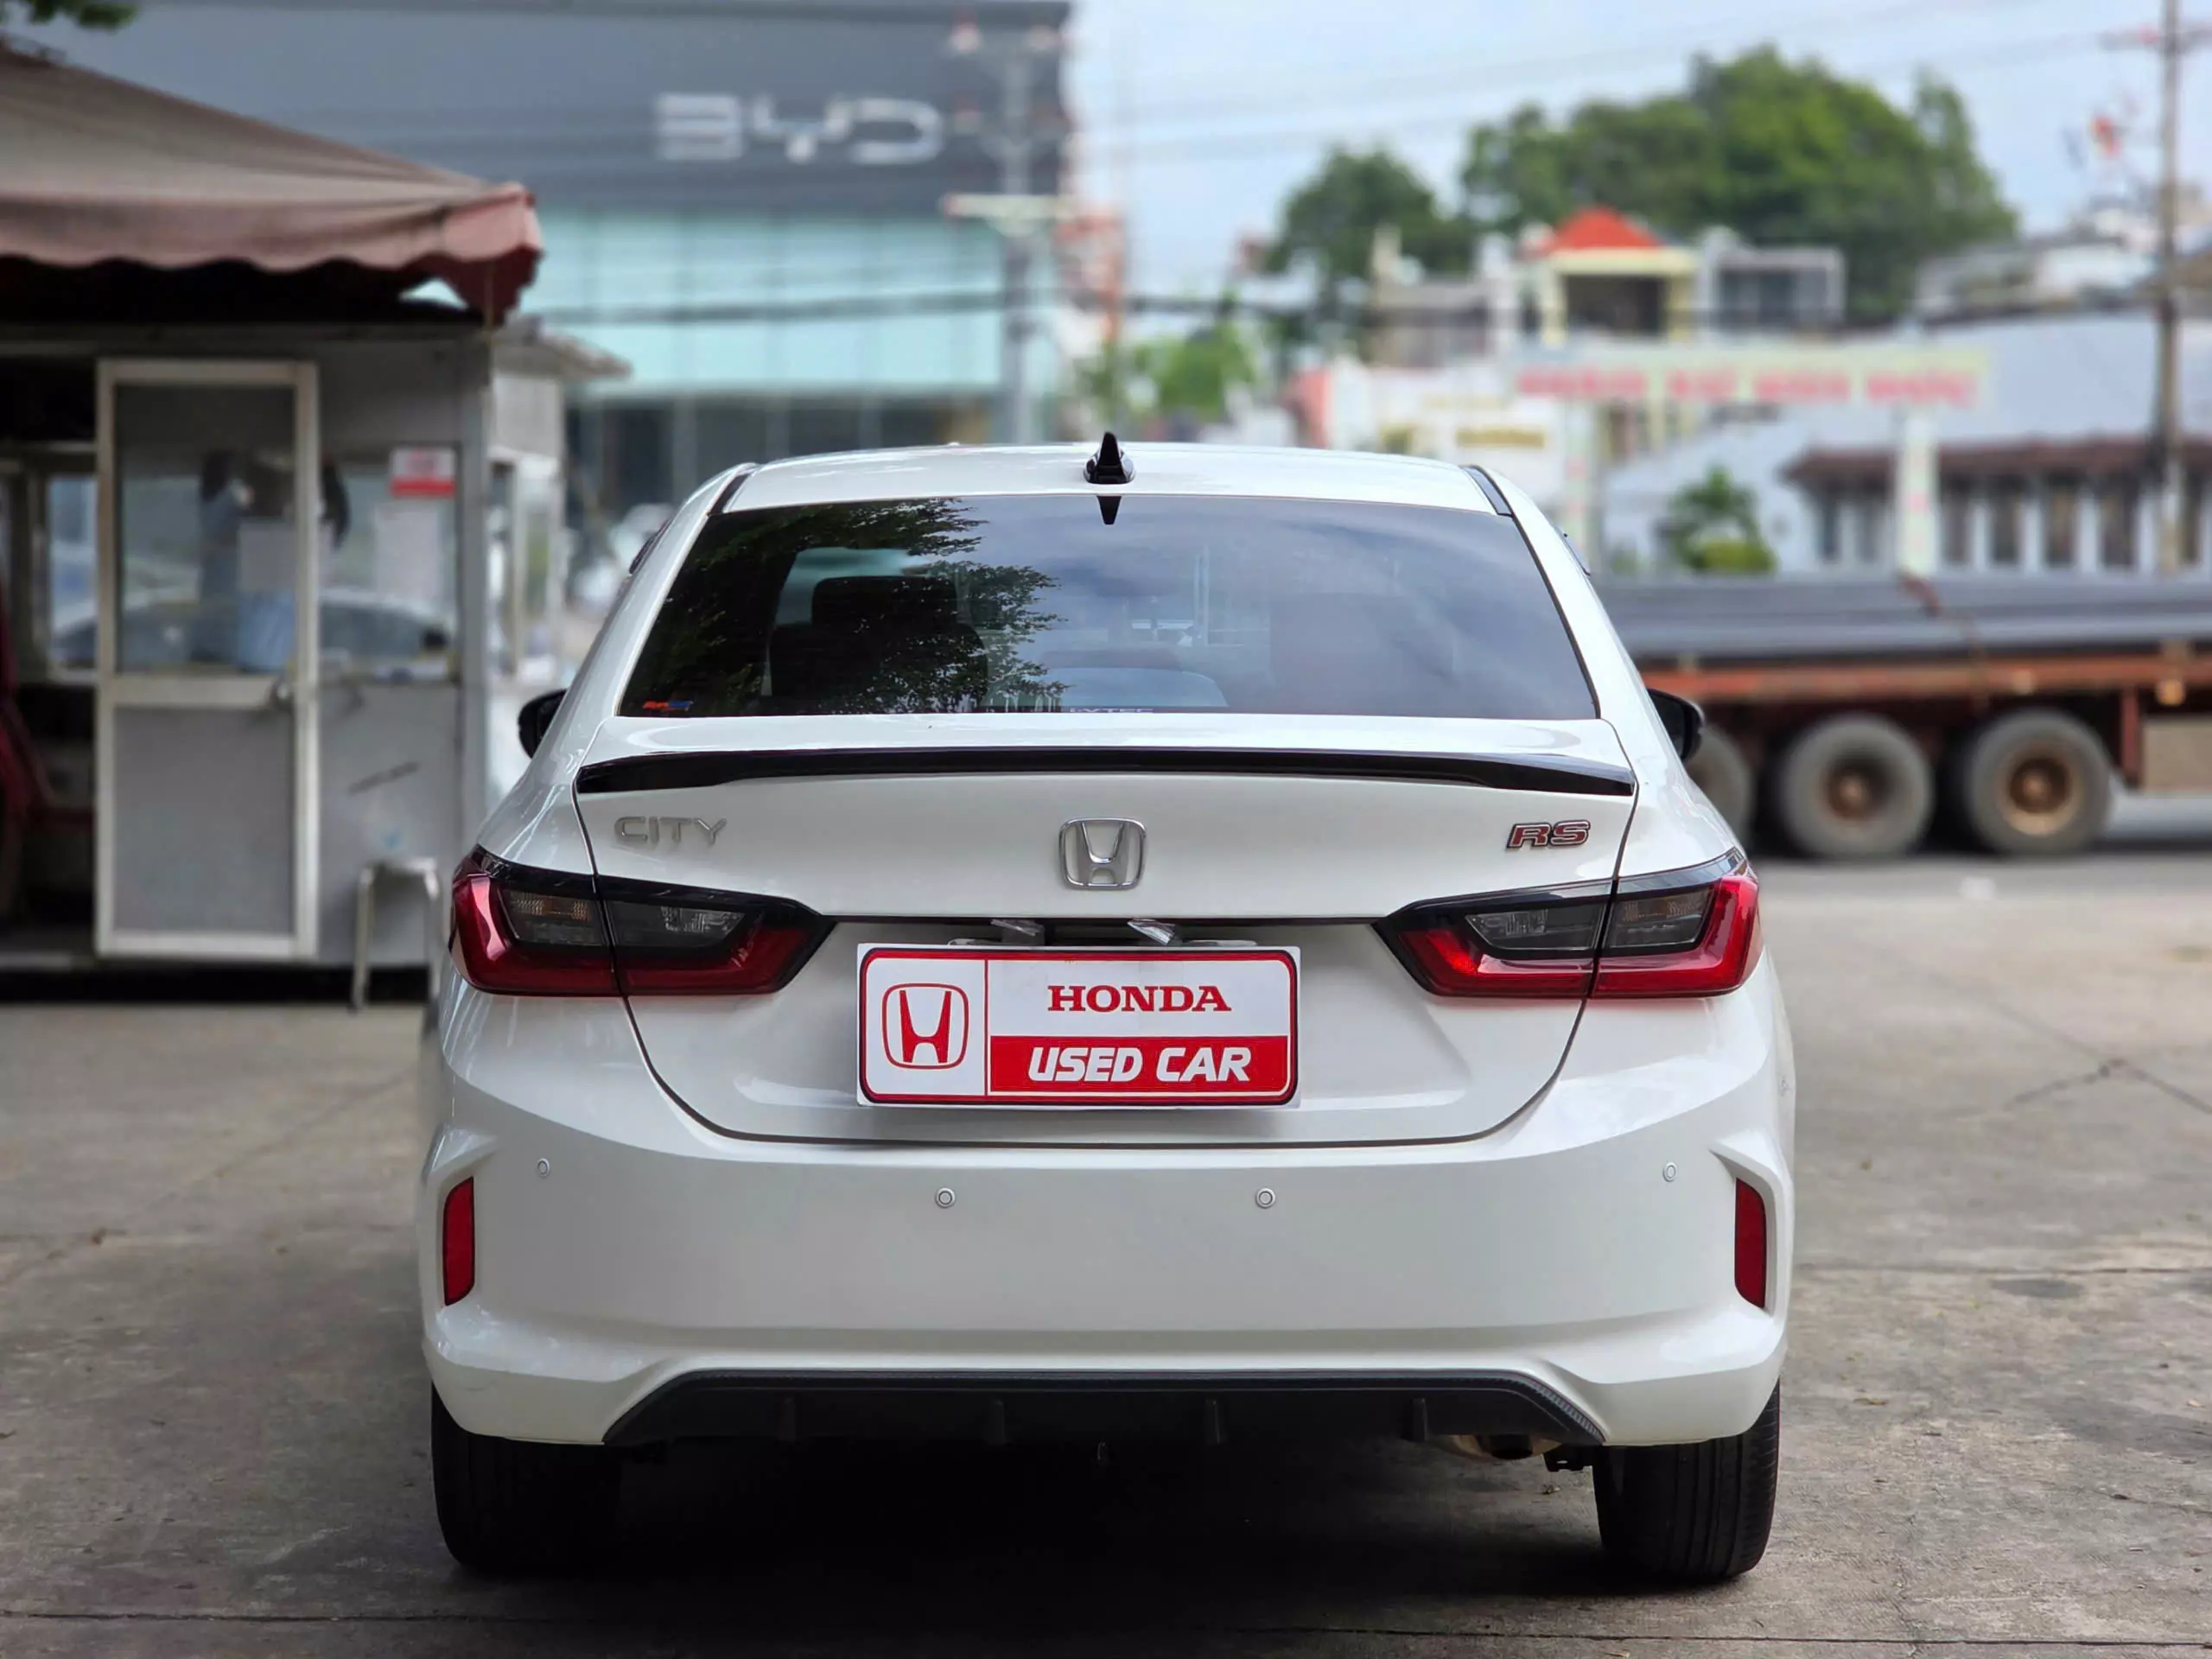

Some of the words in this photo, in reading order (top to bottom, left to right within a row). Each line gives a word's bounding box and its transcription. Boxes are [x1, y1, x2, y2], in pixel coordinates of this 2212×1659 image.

[657, 93, 942, 162] BYD
[614, 816, 728, 845] CITY
[1506, 819, 1591, 848] RS
[1047, 985, 1231, 1012] HONDA
[1028, 1047, 1142, 1083] USED
[1155, 1047, 1252, 1083] CAR
